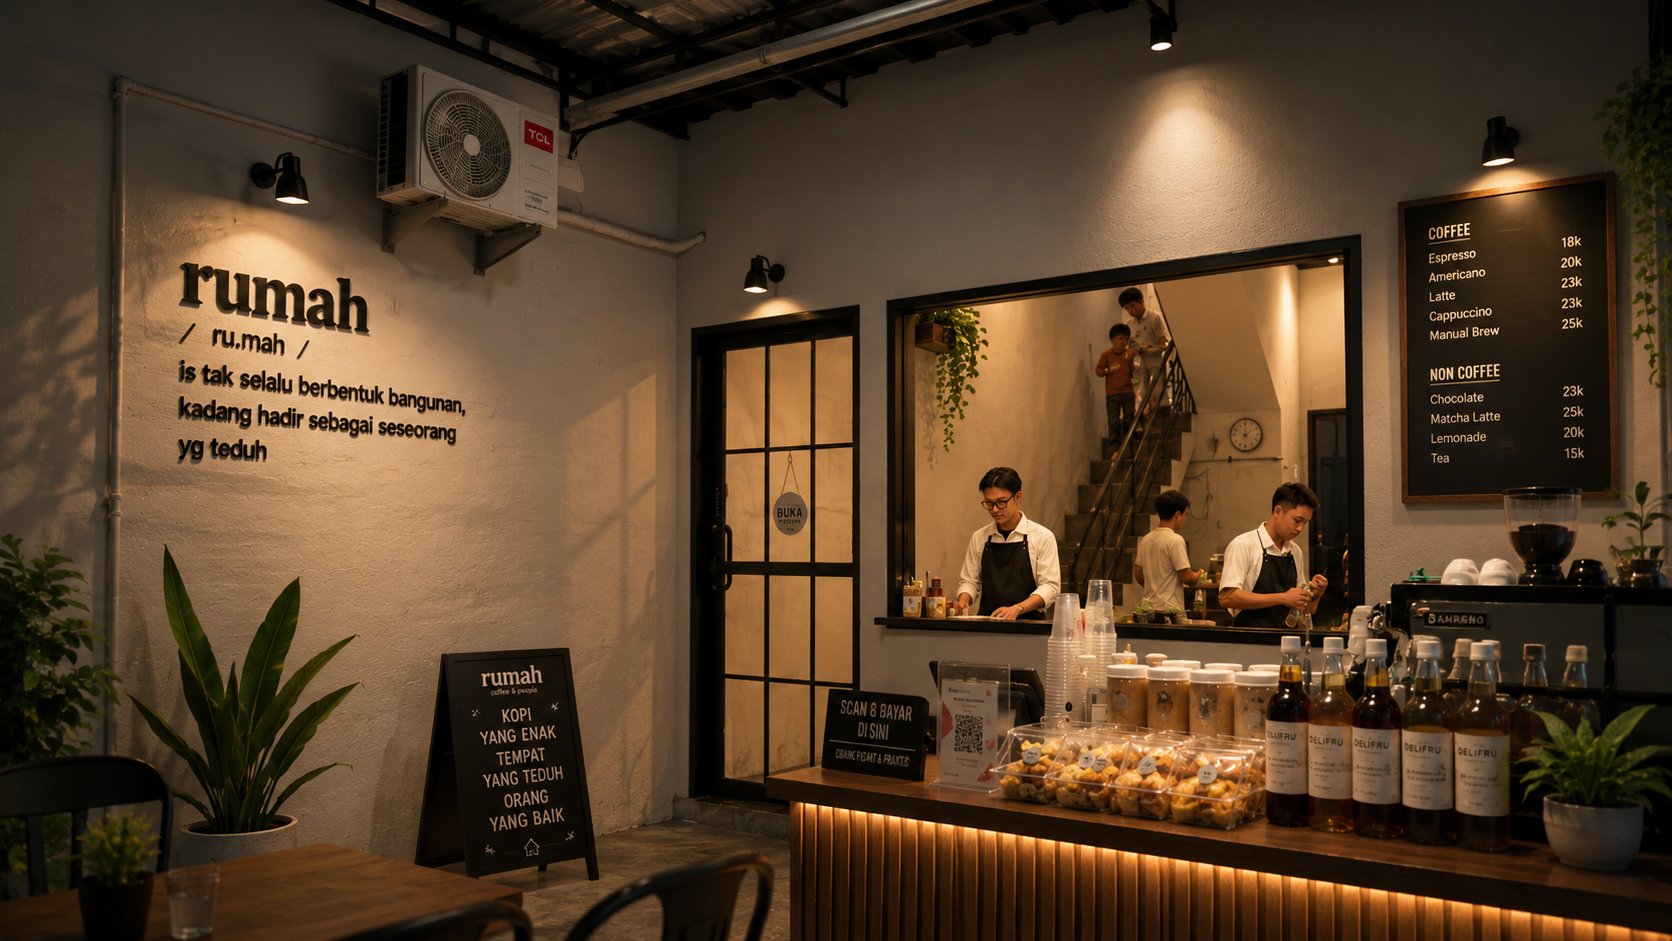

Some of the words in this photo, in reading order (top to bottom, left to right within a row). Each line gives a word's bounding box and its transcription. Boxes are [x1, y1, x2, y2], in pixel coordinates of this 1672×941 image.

[528, 129, 551, 145] TCL
[1428, 222, 1470, 240] COFFEE
[1428, 250, 1476, 265] Espresso
[1562, 236, 1582, 248] 18k
[1428, 268, 1486, 283] Americano
[1561, 256, 1582, 268] 20k
[179, 262, 370, 334] rumah
[1429, 292, 1456, 302] Latte
[1561, 276, 1582, 288] 23k
[1430, 306, 1492, 324] Cappuccino
[1562, 297, 1582, 309] 23k
[1430, 328, 1468, 341] Manual
[1472, 326, 1500, 337] Brew
[1562, 318, 1583, 330] 25k
[212, 327, 285, 356] ru.mah
[1430, 367, 1454, 382] NON
[1458, 364, 1500, 380] COFFEE
[179, 360, 196, 382] is
[202, 364, 234, 386] tak
[240, 370, 293, 394] selalu
[298, 376, 384, 404] berbentuk
[389, 388, 466, 416] bangunan,
[1430, 392, 1484, 405] Chocolate
[1562, 385, 1584, 397] 23k
[178, 396, 252, 428] kadang
[258, 404, 304, 429] hadir
[308, 411, 373, 438] sebagai
[378, 420, 457, 446] seseorang
[1430, 412, 1470, 425] Matcha
[1473, 411, 1500, 422] Latte
[1563, 406, 1584, 418] 25k
[1431, 432, 1487, 444] Lemonade
[1563, 426, 1584, 438] 20k
[178, 438, 204, 464] yg
[210, 438, 267, 462] teduh
[1432, 452, 1450, 463] Tea
[1564, 447, 1585, 459] 15k
[777, 508, 802, 518] BUKA
[481, 665, 543, 687] rumah
[502, 708, 532, 723] KOPI
[840, 700, 867, 717] SCAN
[880, 703, 912, 721] BAYAR
[480, 728, 516, 745] YANG
[522, 725, 556, 741] ENAK
[858, 722, 867, 737] DI
[869, 723, 889, 741] SINI
[1310, 736, 1343, 746] DELIFRU
[1355, 739, 1389, 749] DELIFRU
[1404, 743, 1441, 754] DELIFRU
[1458, 747, 1497, 758] DELIFRU
[496, 747, 545, 766] TEMPAT
[483, 770, 518, 788] YANG
[523, 766, 564, 783] TEDUH
[504, 789, 548, 808] ORANG
[489, 813, 528, 832] YANG
[533, 808, 564, 826] BAIK
